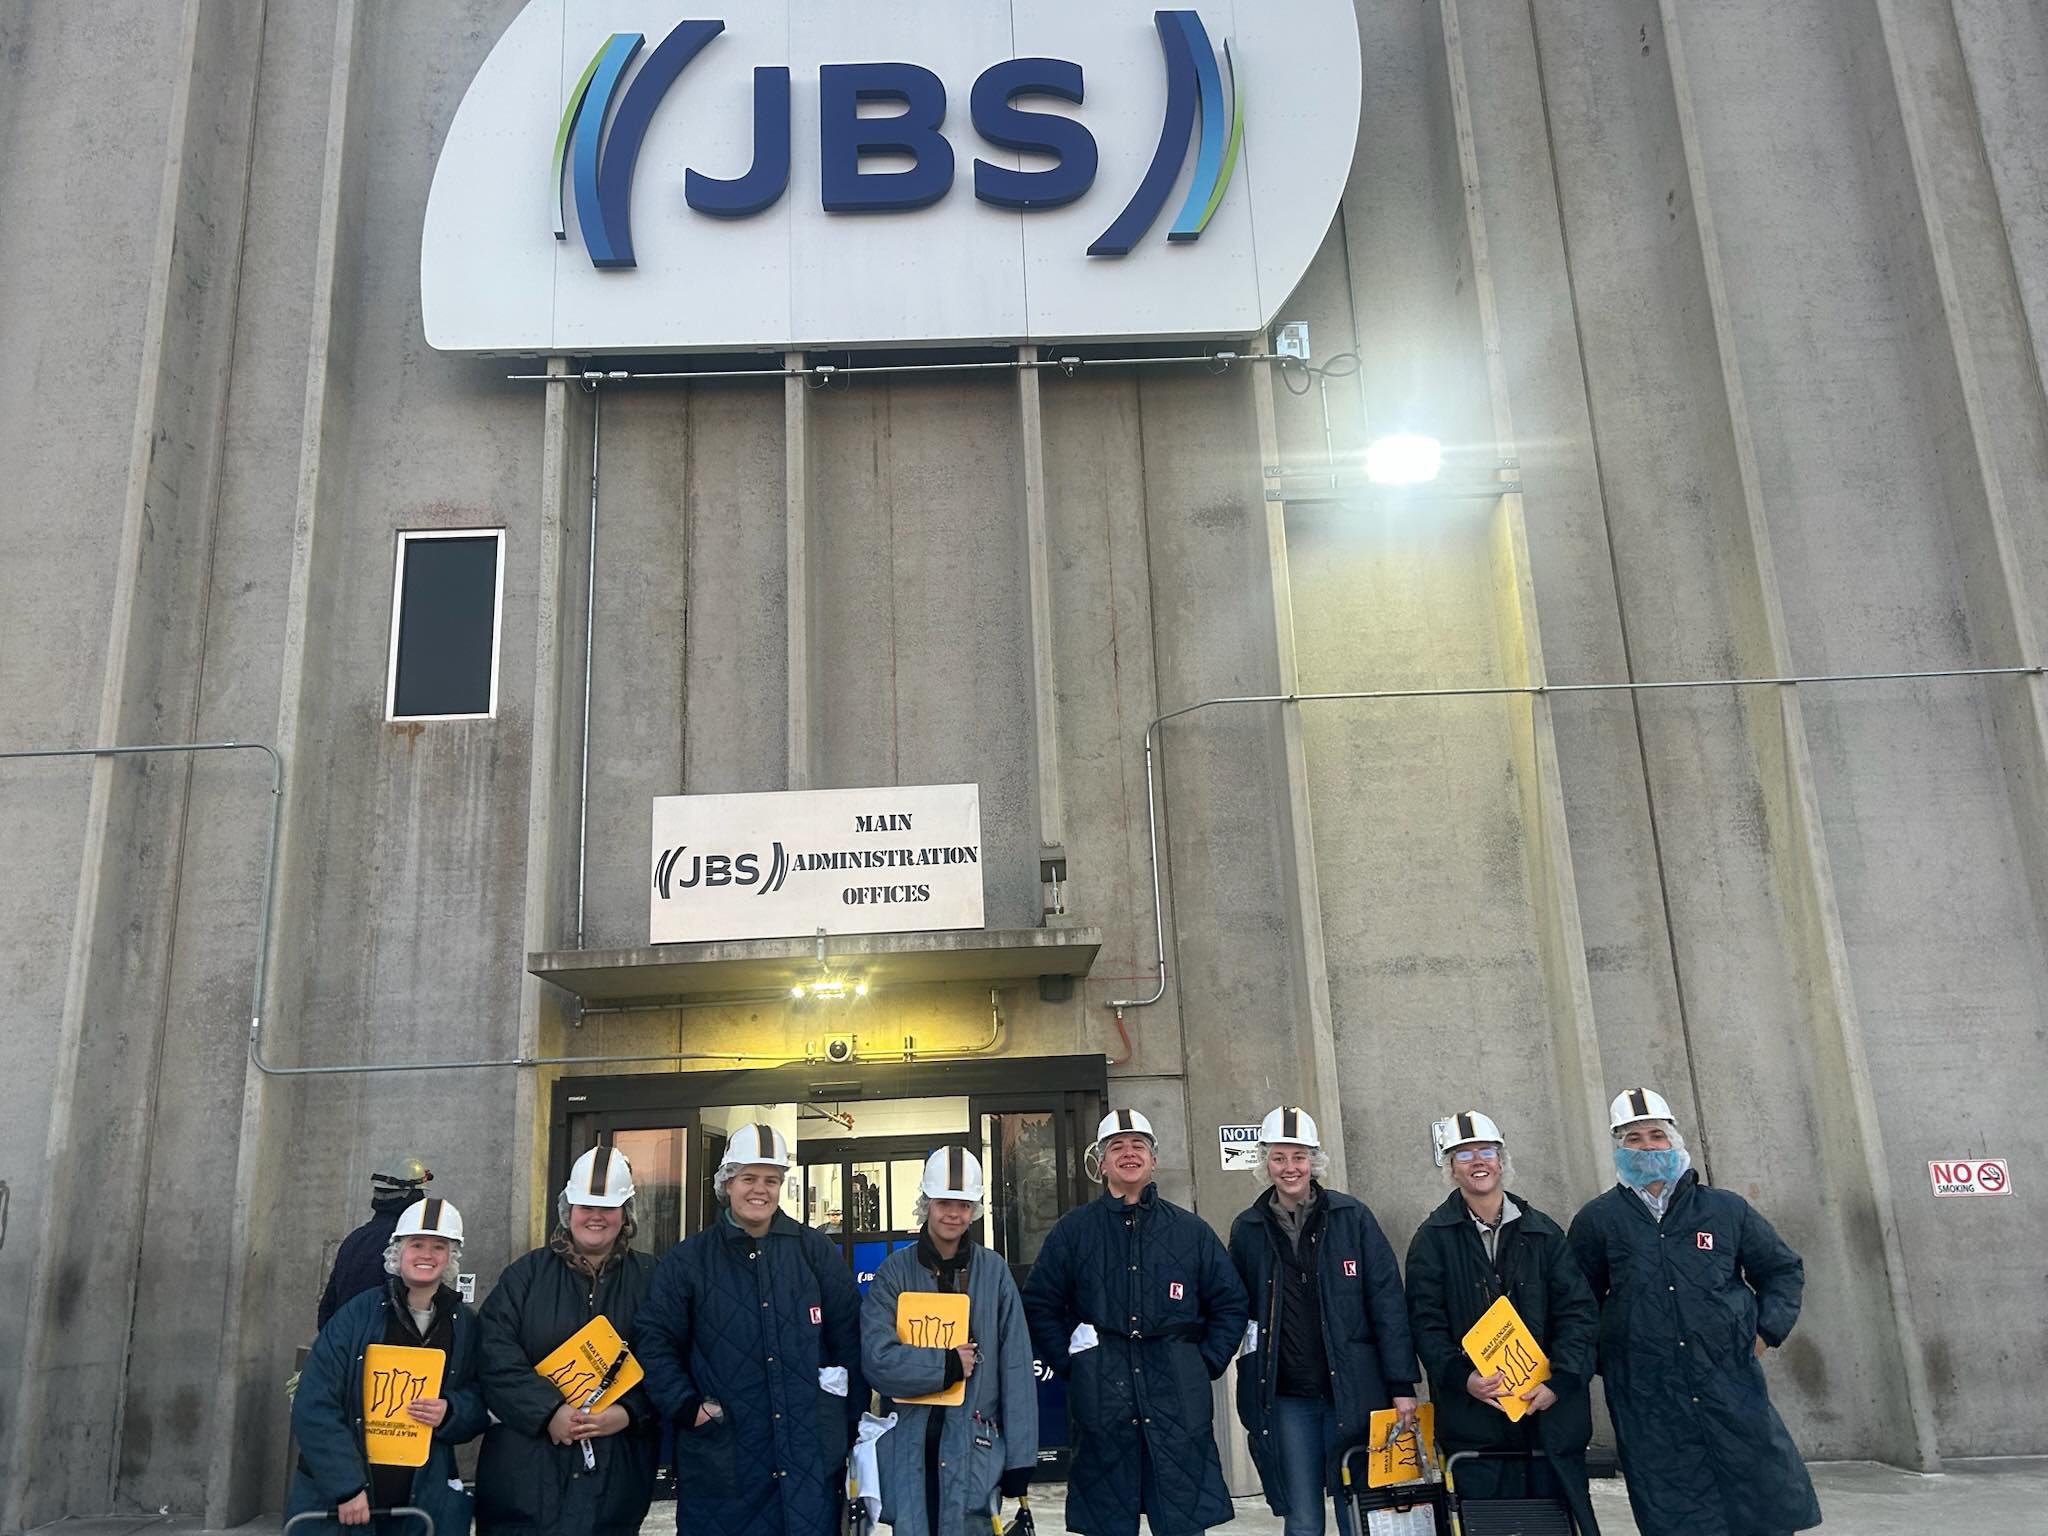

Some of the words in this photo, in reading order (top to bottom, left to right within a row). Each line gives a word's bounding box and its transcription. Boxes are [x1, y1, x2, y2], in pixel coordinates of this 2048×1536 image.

[685, 57, 1099, 219] JBS
[855, 813, 912, 833] MAIN
[792, 846, 978, 871] ADMINISTRATION
[679, 853, 760, 888] JBS
[842, 884, 931, 905] OFFICES
[1223, 1128, 1262, 1141] NOTI
[1933, 1163, 1972, 1184] NO
[1937, 1184, 1975, 1193] SMOKING
[862, 1273, 875, 1282] JB
[585, 1340, 601, 1358] MEAT
[366, 1428, 397, 1437] JUDGIN
